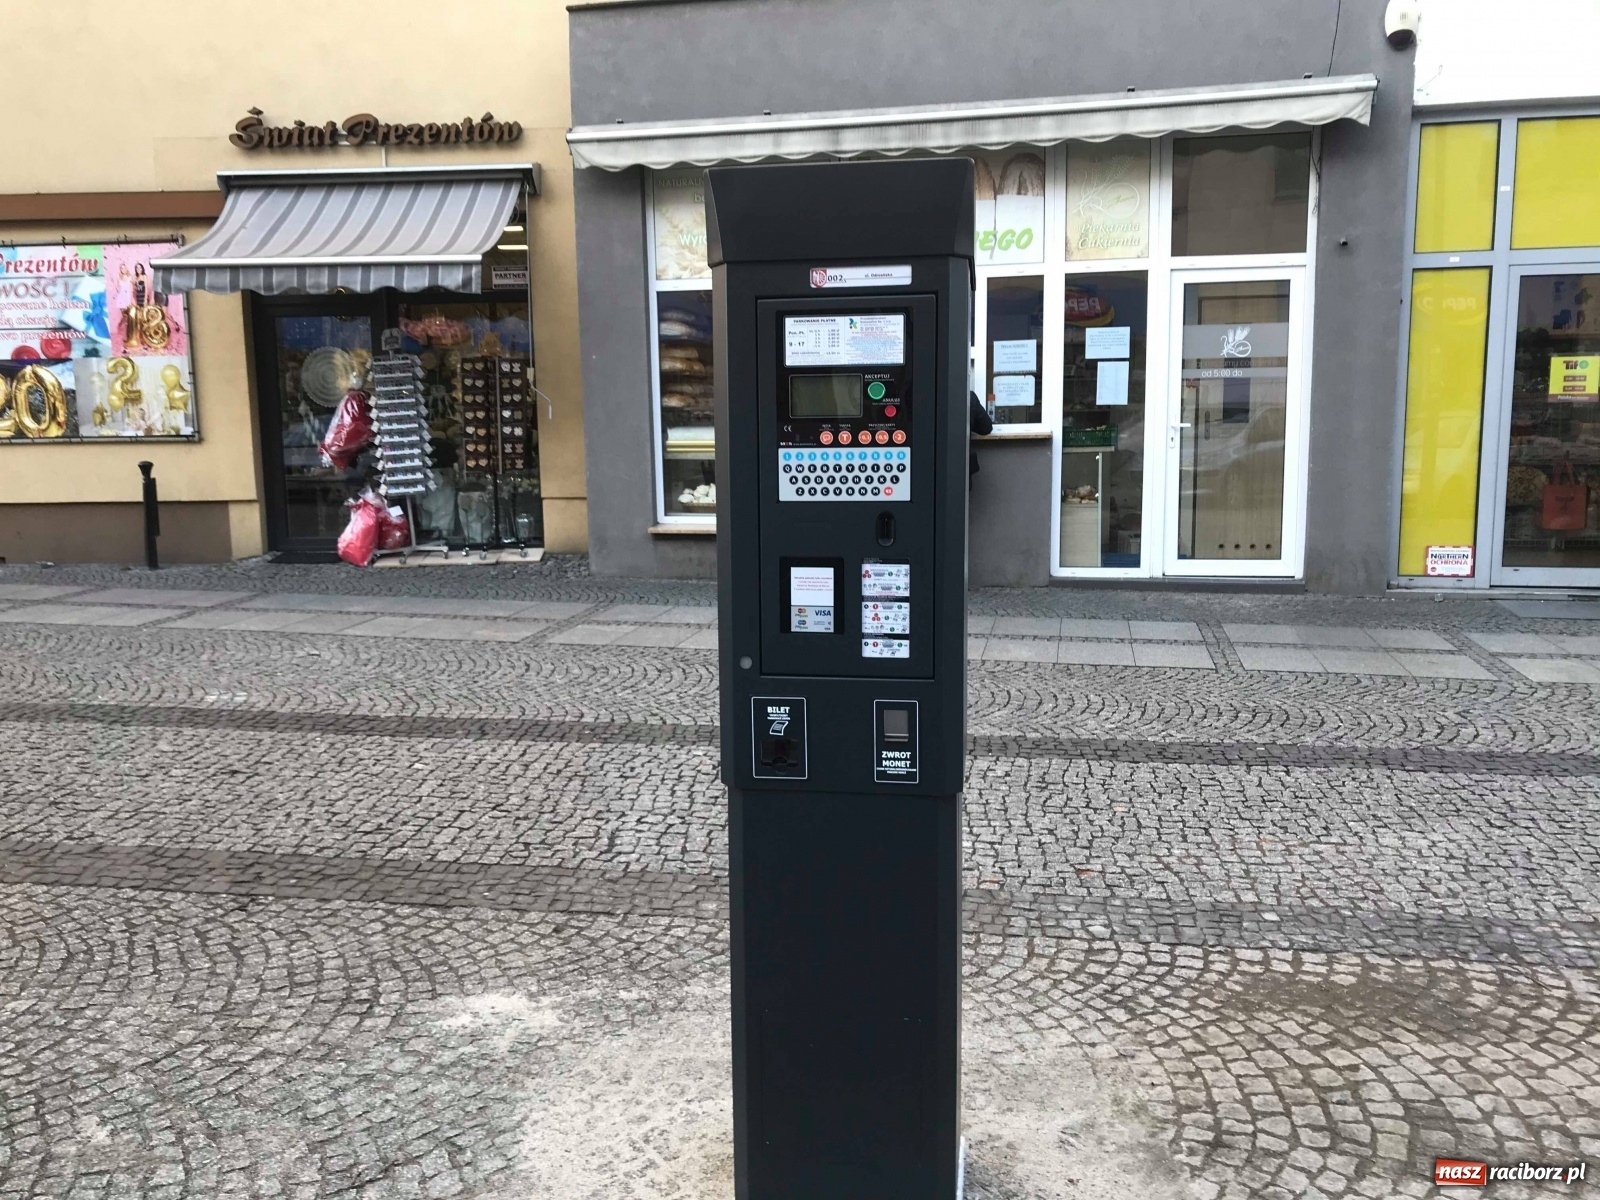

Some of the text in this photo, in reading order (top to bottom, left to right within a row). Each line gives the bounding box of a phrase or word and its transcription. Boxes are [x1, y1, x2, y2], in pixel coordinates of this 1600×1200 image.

[228, 106, 524, 149] Świat Prezentów
[494, 272, 527, 280] PARTNER
[1213, 369, 1231, 377] 5:00
[1231, 369, 1243, 377] do
